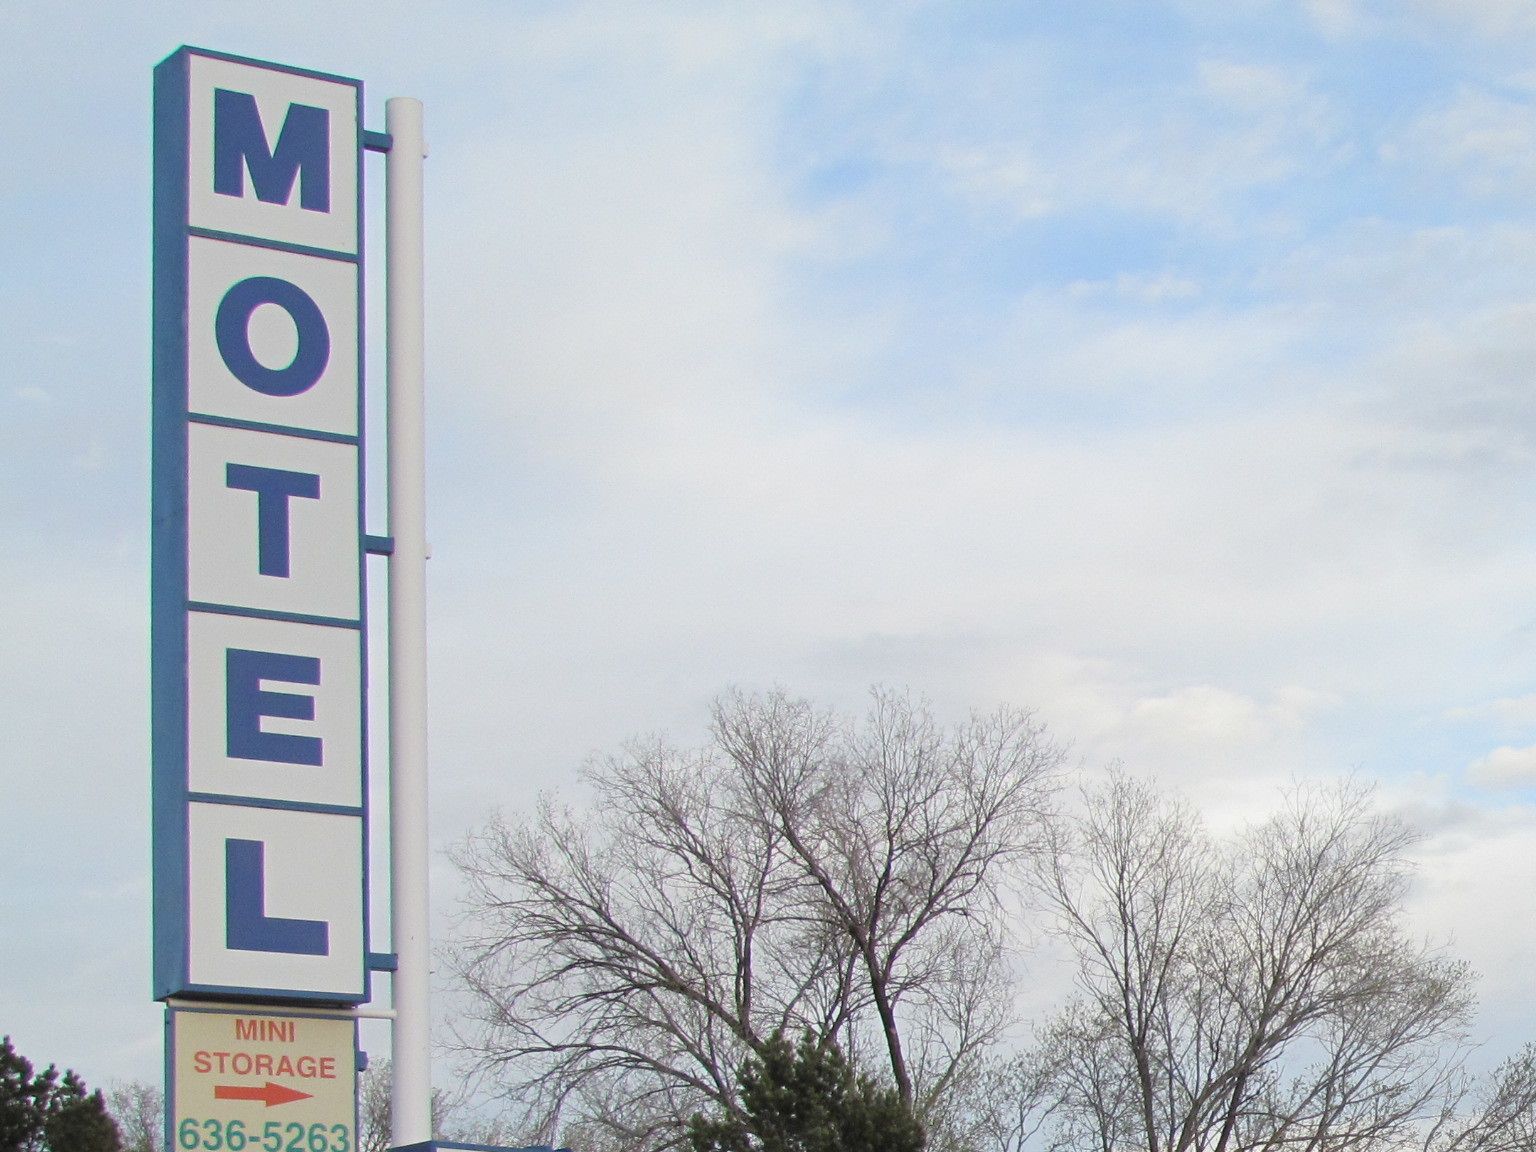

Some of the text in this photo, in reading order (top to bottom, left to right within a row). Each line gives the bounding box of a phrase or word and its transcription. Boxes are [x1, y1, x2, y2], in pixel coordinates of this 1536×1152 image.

[213, 87, 331, 956] MOTEL
[235, 1018, 296, 1043] MINI
[193, 1050, 337, 1080] STORAGE
